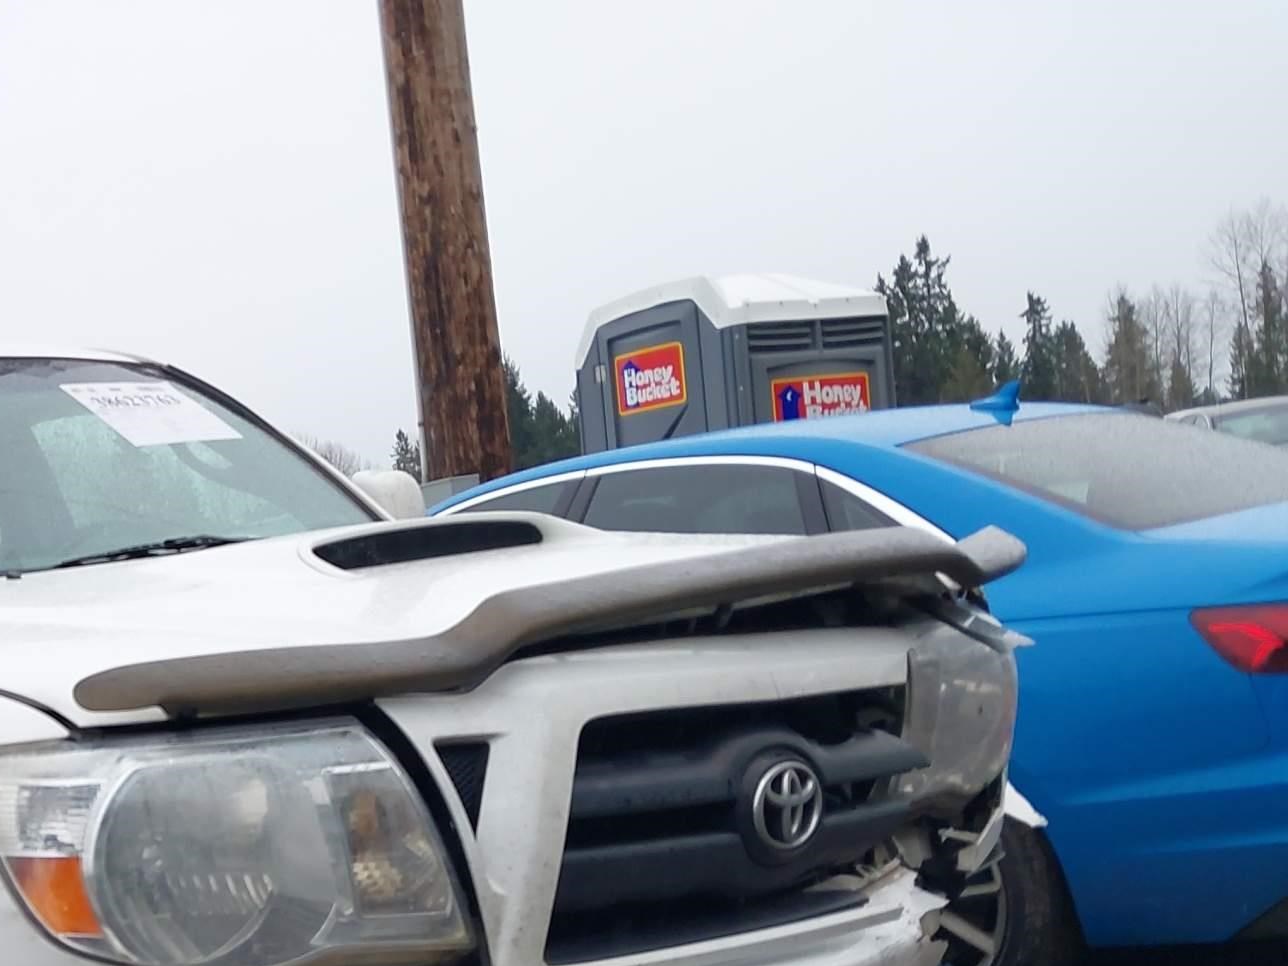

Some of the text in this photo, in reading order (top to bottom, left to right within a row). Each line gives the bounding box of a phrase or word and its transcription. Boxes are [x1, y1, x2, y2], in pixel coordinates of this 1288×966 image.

[624, 364, 673, 388] Honey
[90, 394, 182, 408] 38623763
[626, 376, 681, 407] Bucket
[803, 381, 862, 406] Honey
